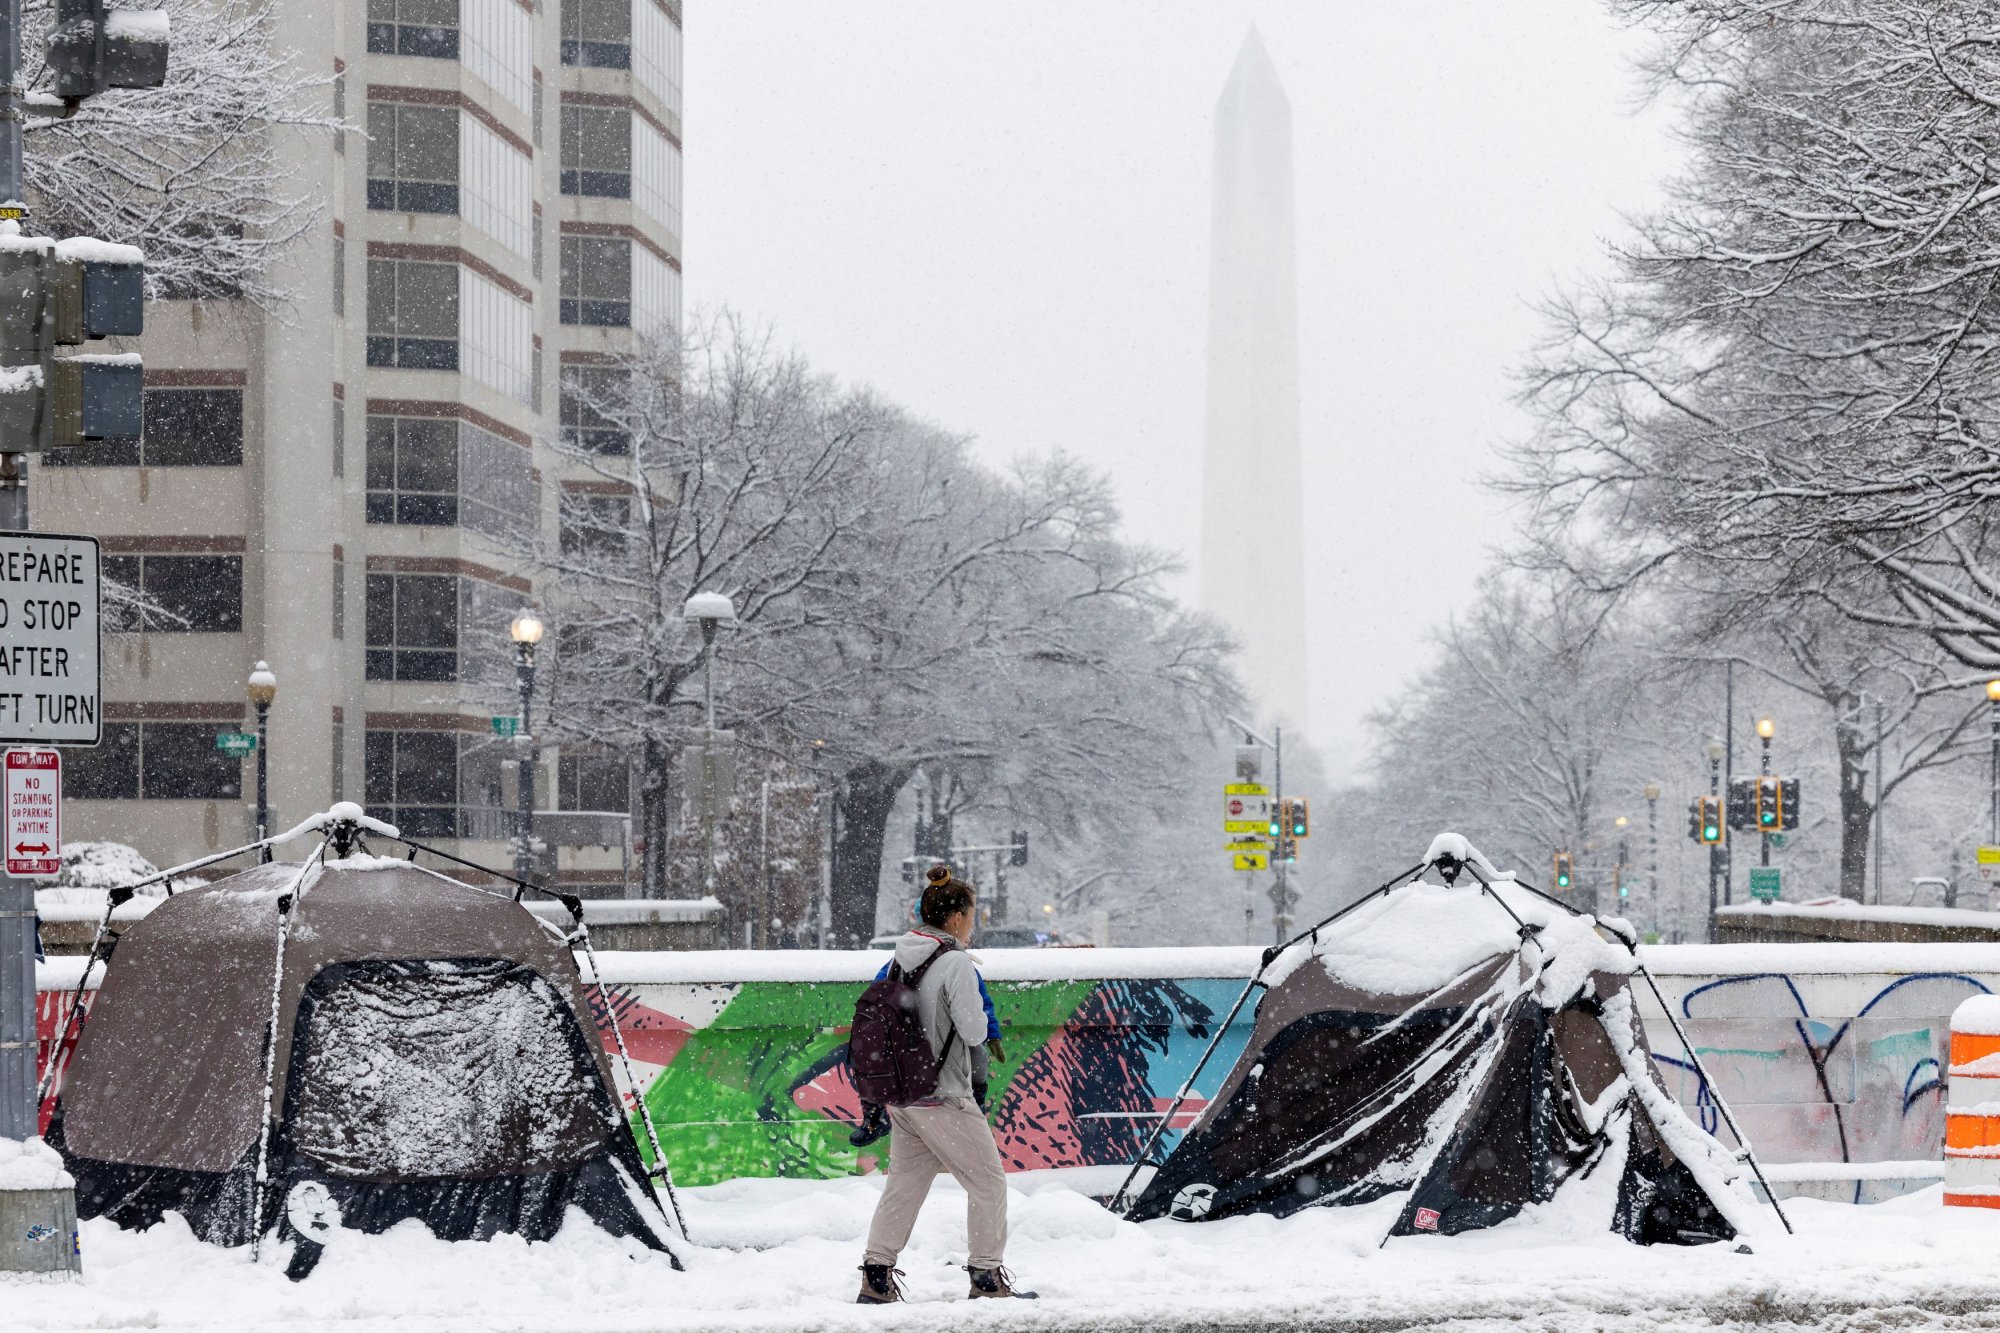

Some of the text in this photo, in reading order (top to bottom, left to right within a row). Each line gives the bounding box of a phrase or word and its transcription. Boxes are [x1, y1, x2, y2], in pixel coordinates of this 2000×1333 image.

[23, 599, 81, 631] STOP
[0, 646, 69, 677] AFTER
[35, 694, 94, 724] TURN
[11, 754, 54, 765] TOW AWAY
[25, 777, 40, 789] NO
[13, 793, 53, 805] STANDING
[12, 807, 53, 818] OR PARKING
[16, 821, 49, 834] ANYTIME
[9, 861, 15, 870] IF
[35, 861, 49, 871] ALL
